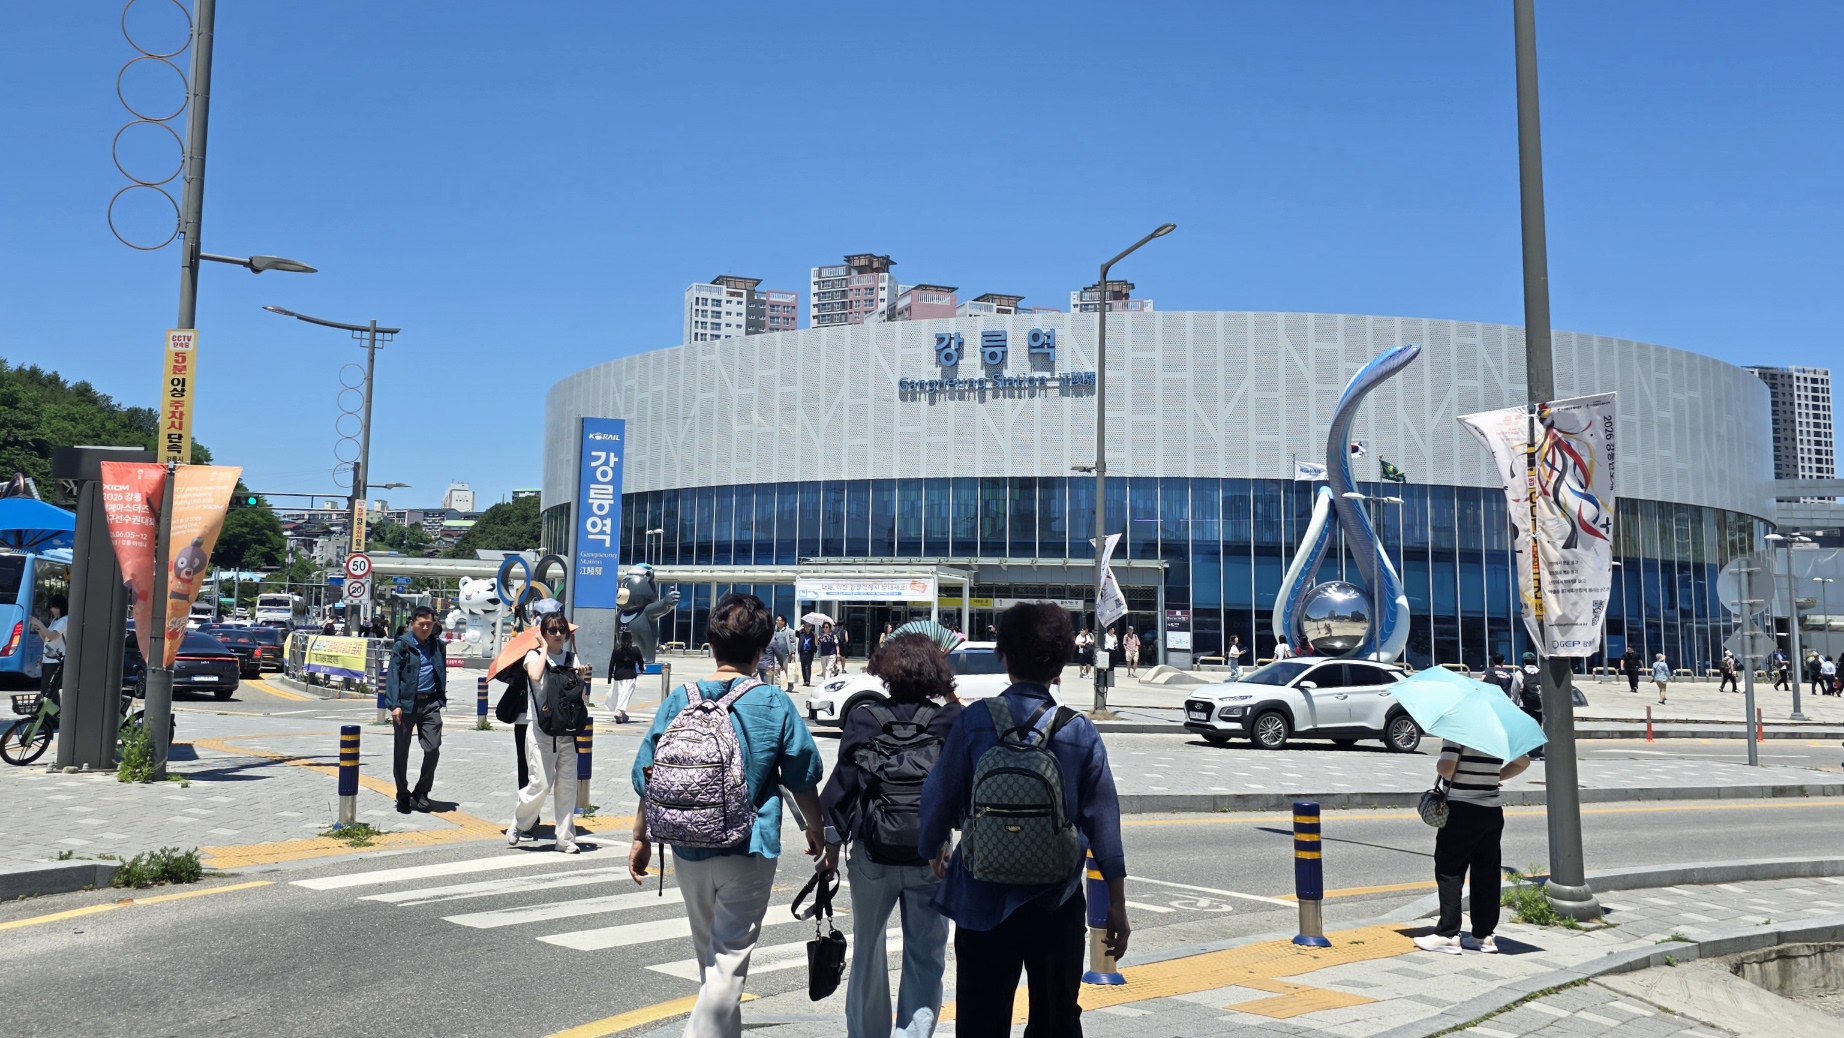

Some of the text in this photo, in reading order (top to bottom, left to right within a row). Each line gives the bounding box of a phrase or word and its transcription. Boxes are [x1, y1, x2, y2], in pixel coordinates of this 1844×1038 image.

[934, 328, 1056, 367] 강릉역
[172, 352, 188, 375] 5분
[169, 377, 187, 398] 이상
[898, 372, 1048, 395] Gangneung Station
[589, 432, 621, 441] KORAIL
[1603, 415, 1614, 441] 2026
[166, 433, 184, 454] 단속
[125, 492, 142, 502] 강릉
[586, 451, 619, 548] 강릉역
[580, 551, 618, 559] Gangneung
[352, 561, 366, 571] 50
[351, 586, 362, 594] 20
[1560, 640, 1581, 648] GEP
